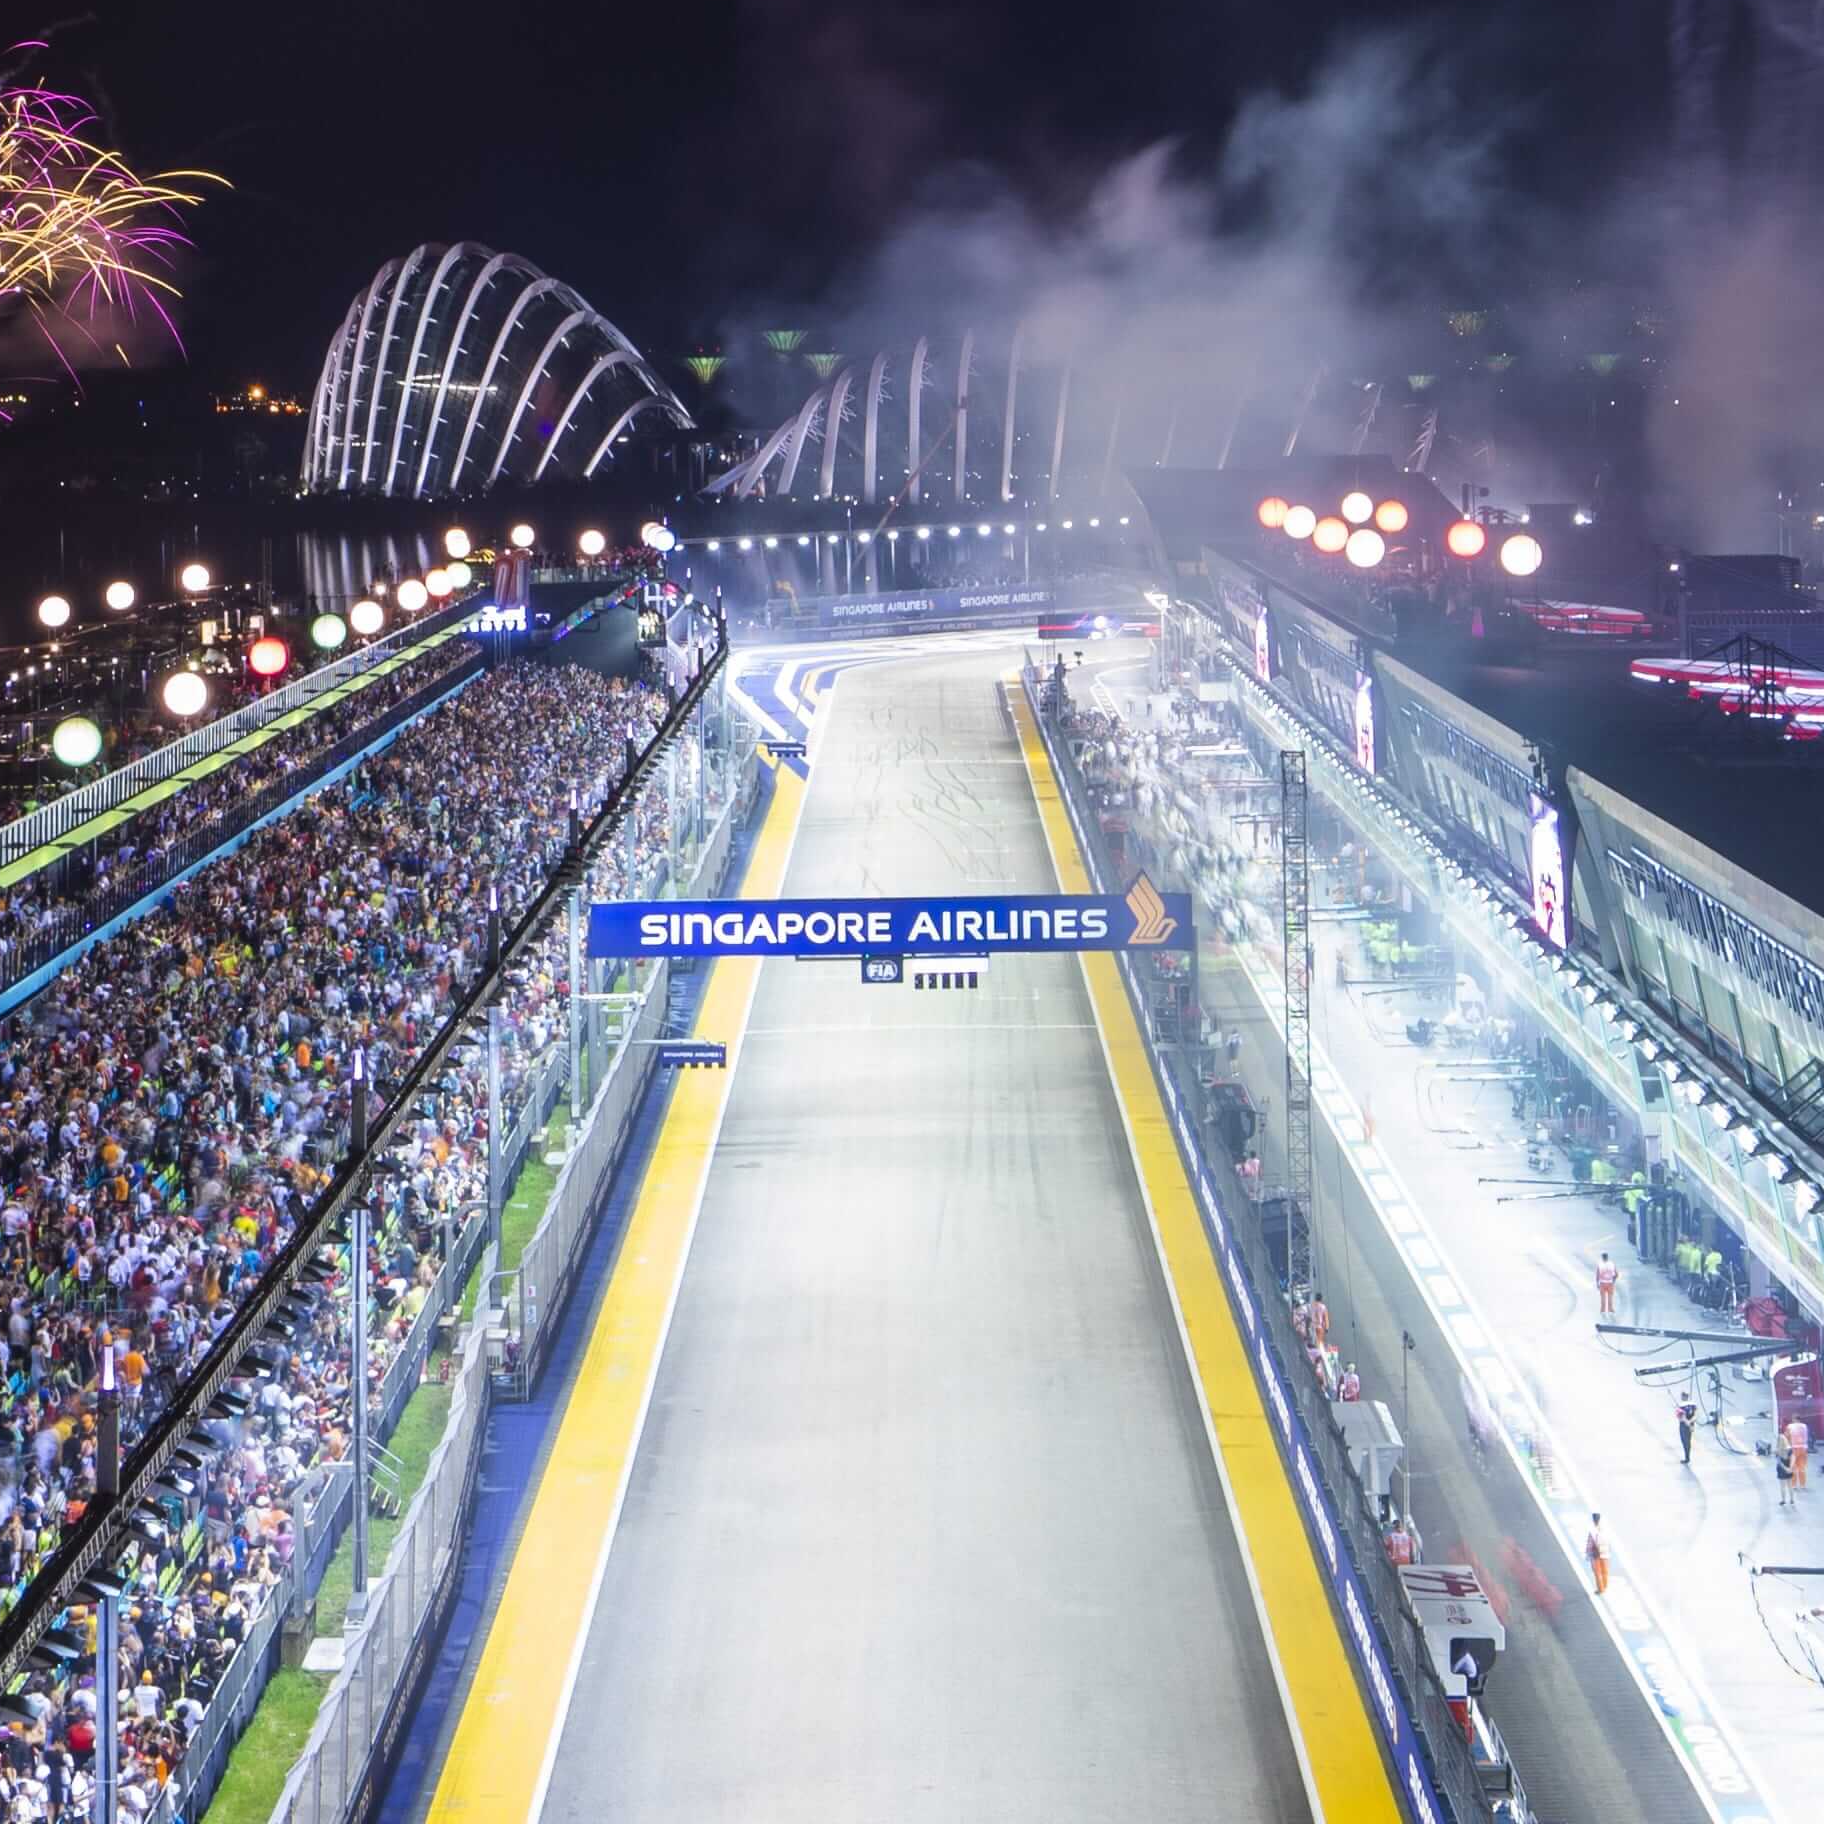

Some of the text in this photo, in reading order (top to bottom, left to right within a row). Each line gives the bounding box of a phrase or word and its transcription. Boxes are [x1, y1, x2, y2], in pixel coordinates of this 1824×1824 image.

[832, 600, 928, 617] SINGAPORE AIRLINES
[960, 594, 1009, 608] SINGAPORE
[640, 908, 1108, 946] SINGAPORE AIRLINES
[867, 962, 897, 979] FIA
